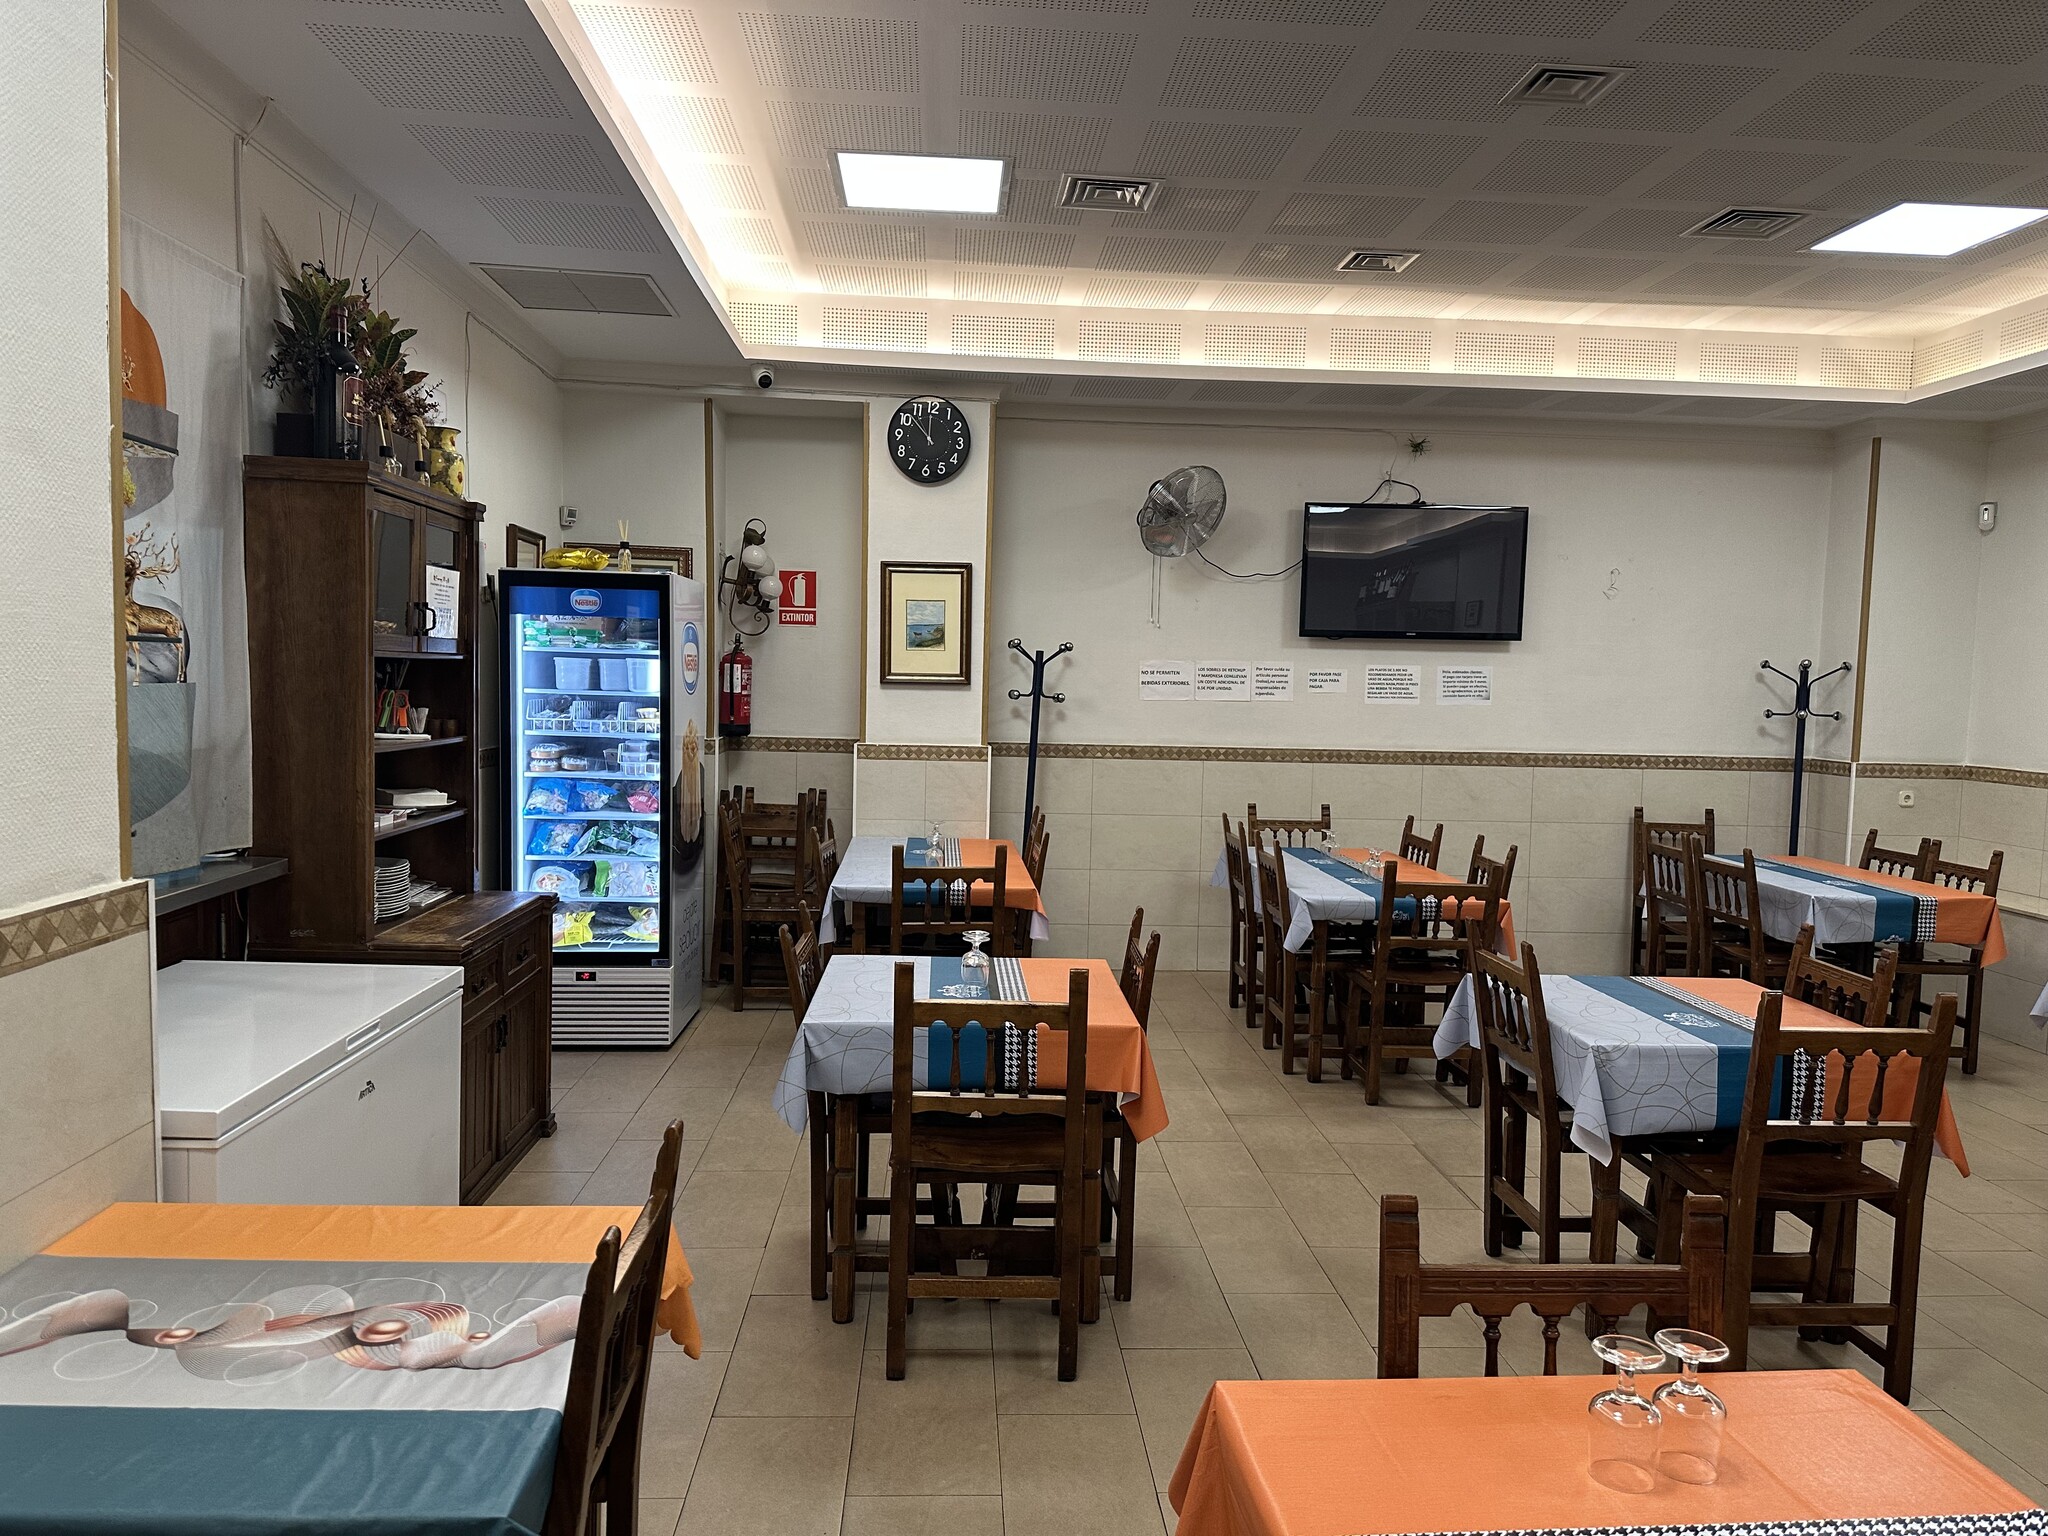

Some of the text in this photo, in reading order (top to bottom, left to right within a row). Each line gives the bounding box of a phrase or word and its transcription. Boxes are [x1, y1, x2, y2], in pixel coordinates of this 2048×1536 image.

[913, 404, 922, 416] 11
[927, 401, 939, 414] 12
[900, 413, 911, 426] 10
[947, 408, 951, 420] 1
[954, 421, 962, 433] 2
[895, 428, 903, 440] 9
[956, 437, 964, 449] 3
[898, 445, 905, 457] 8
[908, 458, 915, 470] 7
[950, 453, 958, 464] 4
[922, 464, 930, 476] 6
[937, 462, 946, 474] 5
[782, 613, 814, 622] EXTINTOR
